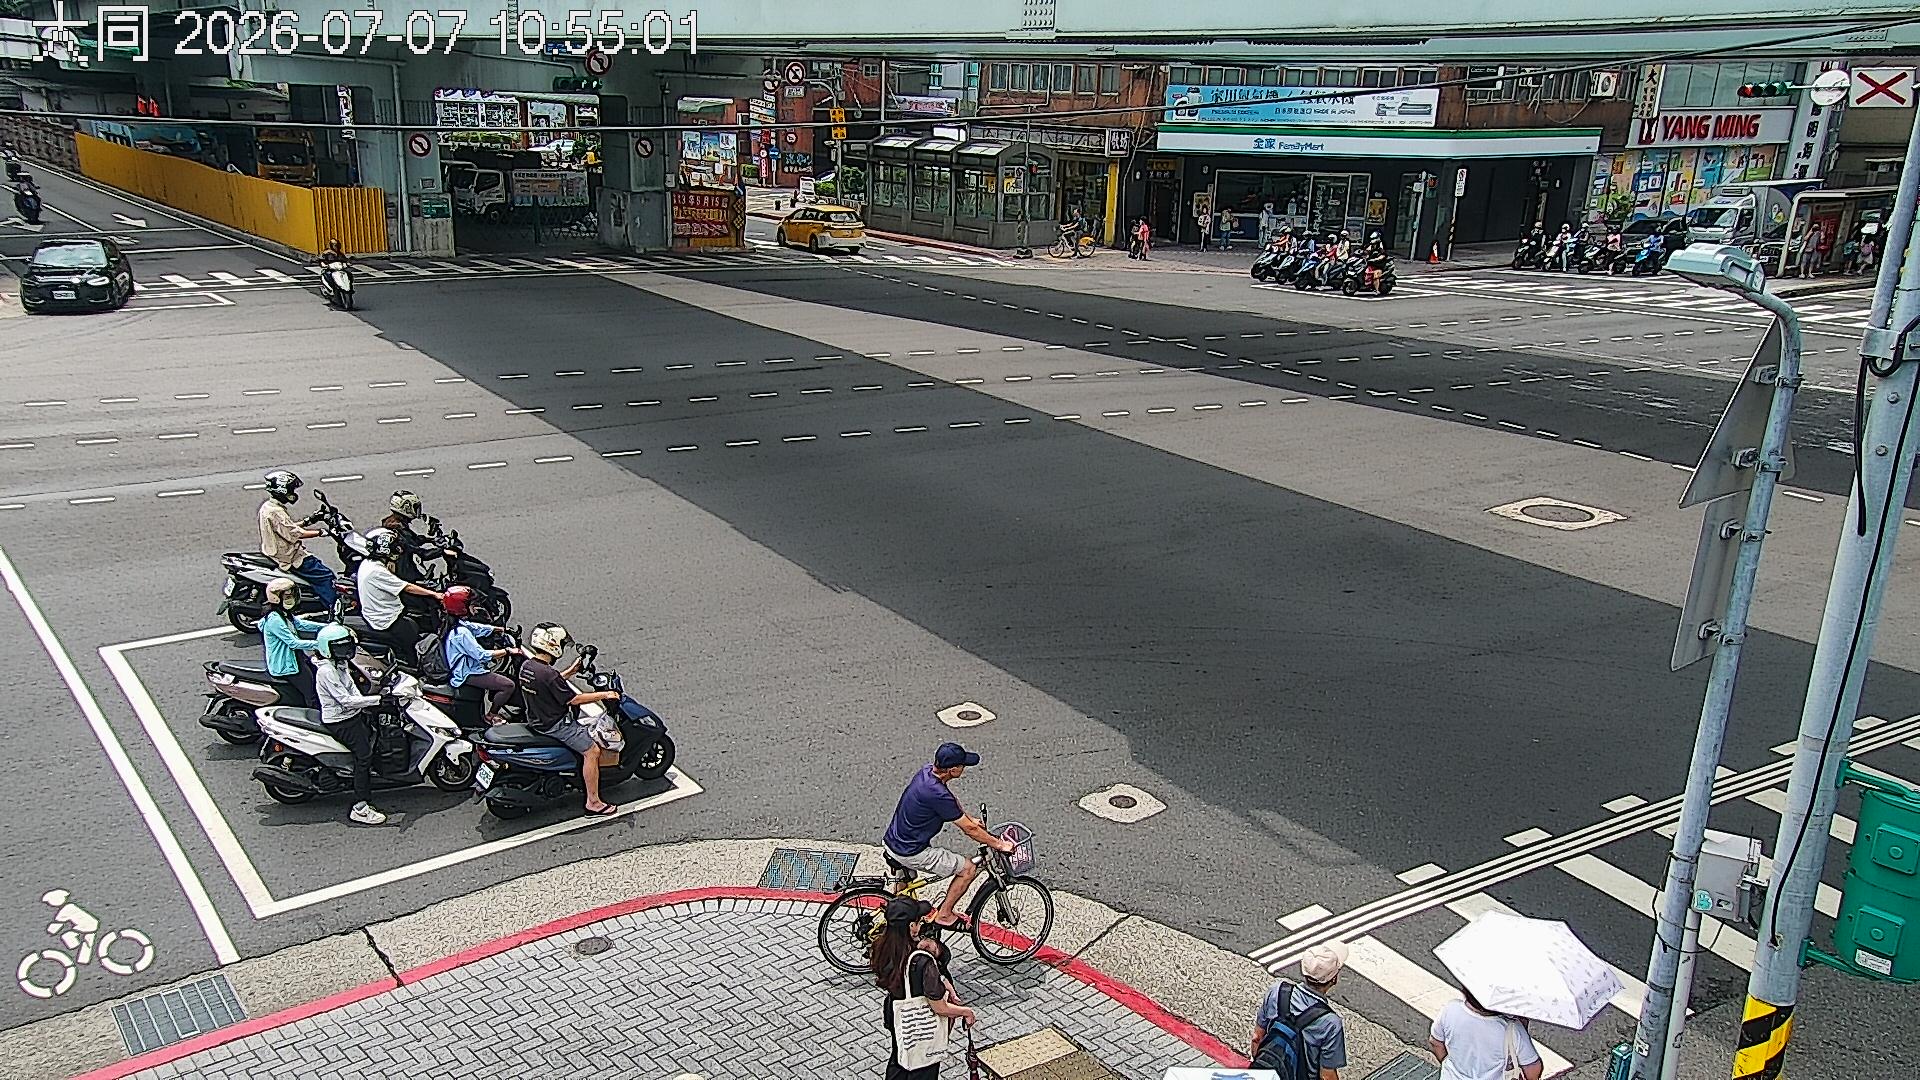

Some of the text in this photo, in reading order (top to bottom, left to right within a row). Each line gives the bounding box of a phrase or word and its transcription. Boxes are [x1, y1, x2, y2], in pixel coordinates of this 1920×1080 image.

[1662, 114, 1762, 140] YANG MING
[1253, 137, 1325, 153] 全家 FamilyMart
